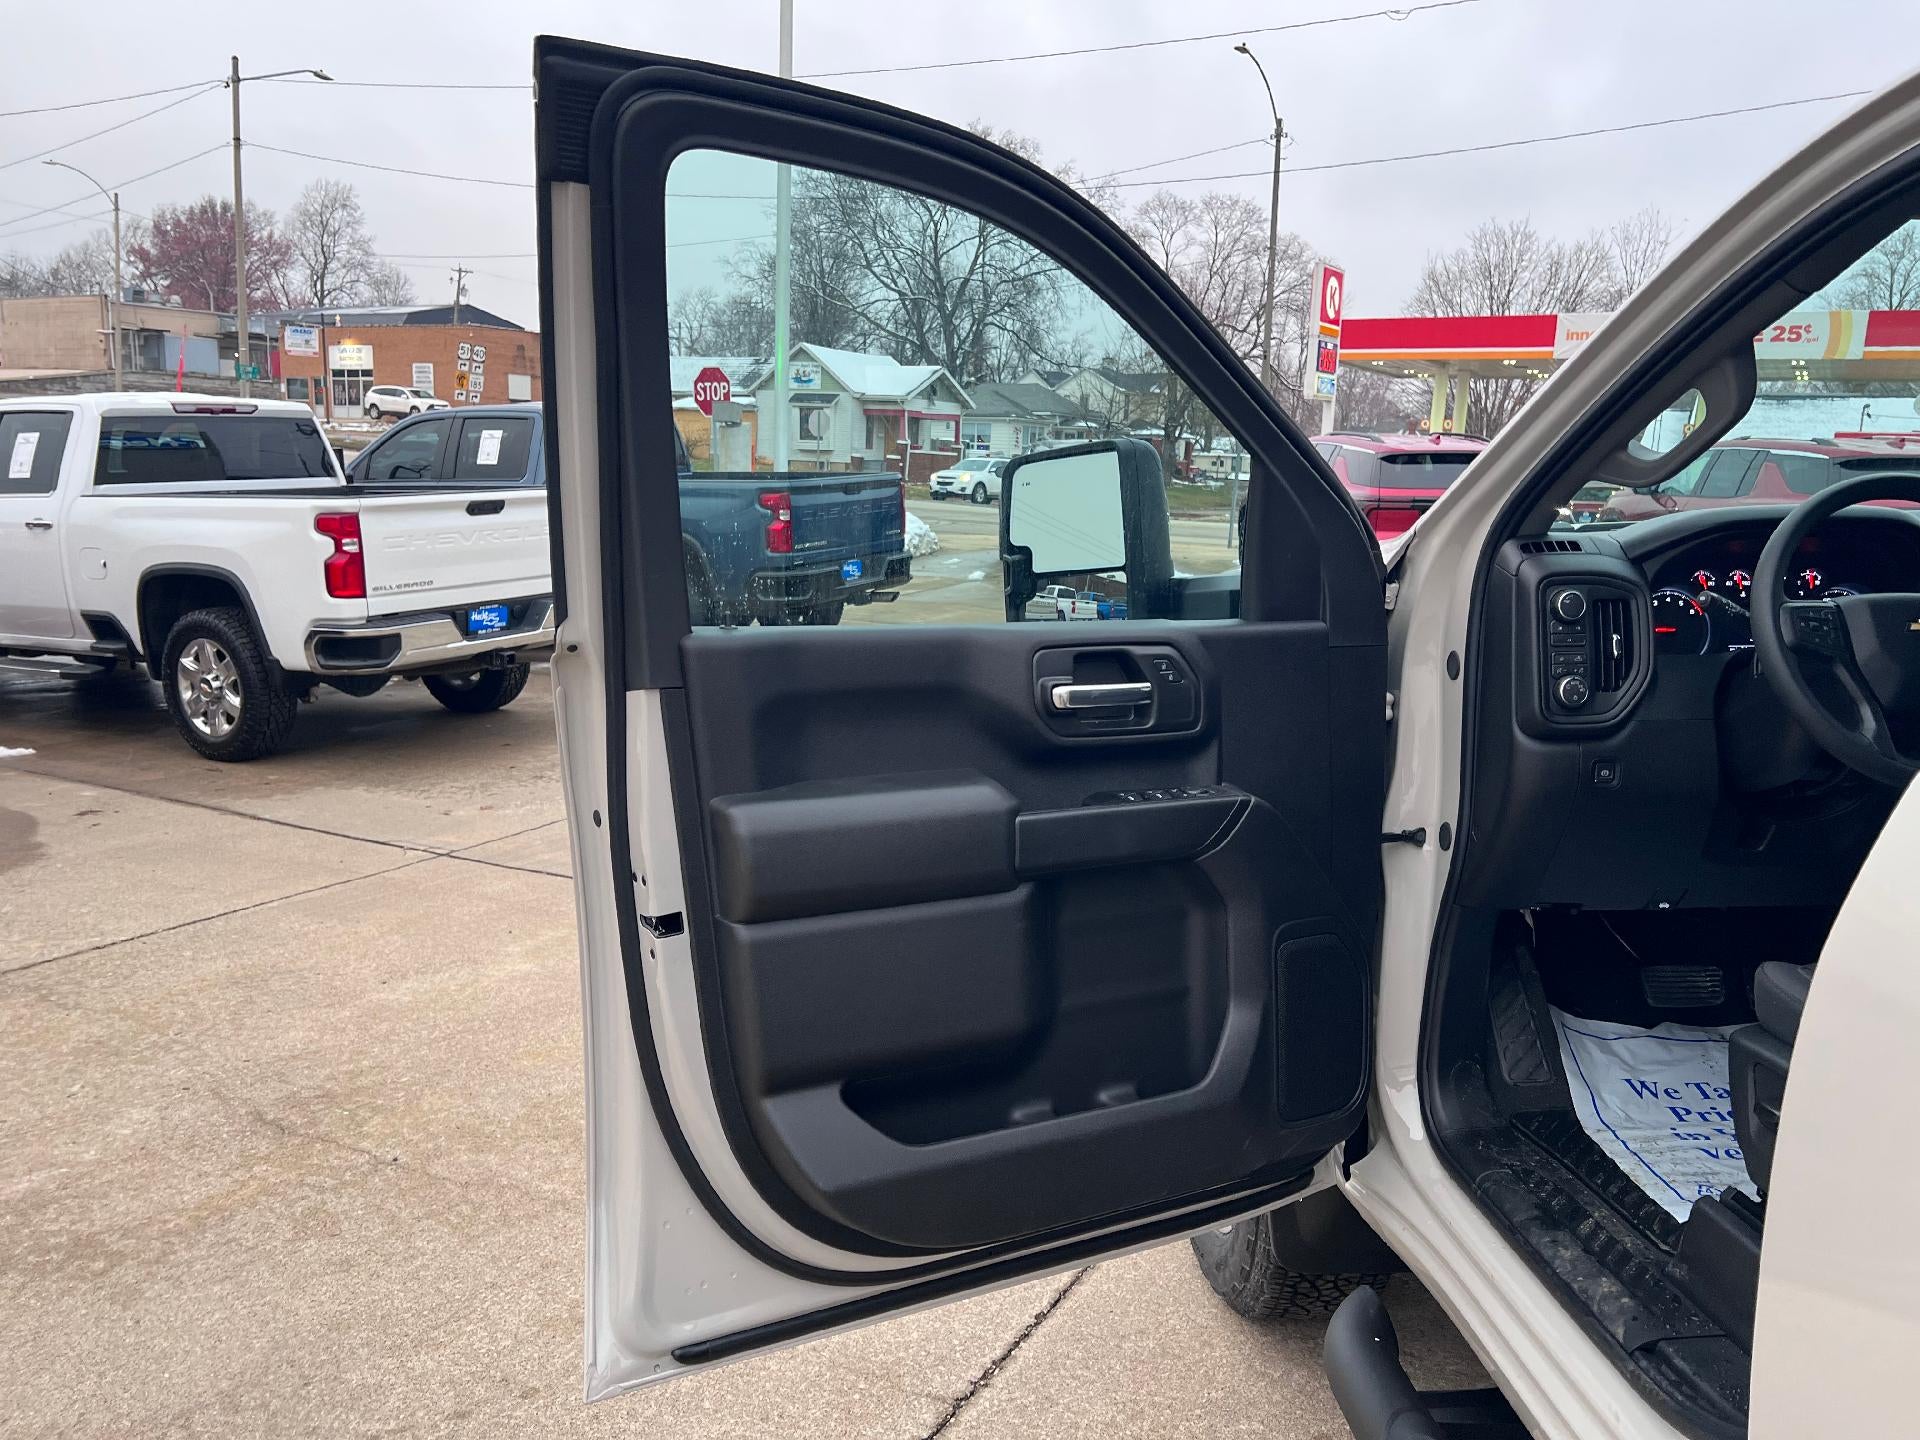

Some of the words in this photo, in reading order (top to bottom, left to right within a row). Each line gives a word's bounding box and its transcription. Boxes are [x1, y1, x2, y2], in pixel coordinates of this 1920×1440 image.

[1566, 328, 1596, 341] inn
[460, 345, 470, 355] 51
[474, 349, 485, 359] 40
[696, 382, 729, 401] STOP
[1621, 1078, 1682, 1100] We
[1685, 1082, 1730, 1100] Ta
